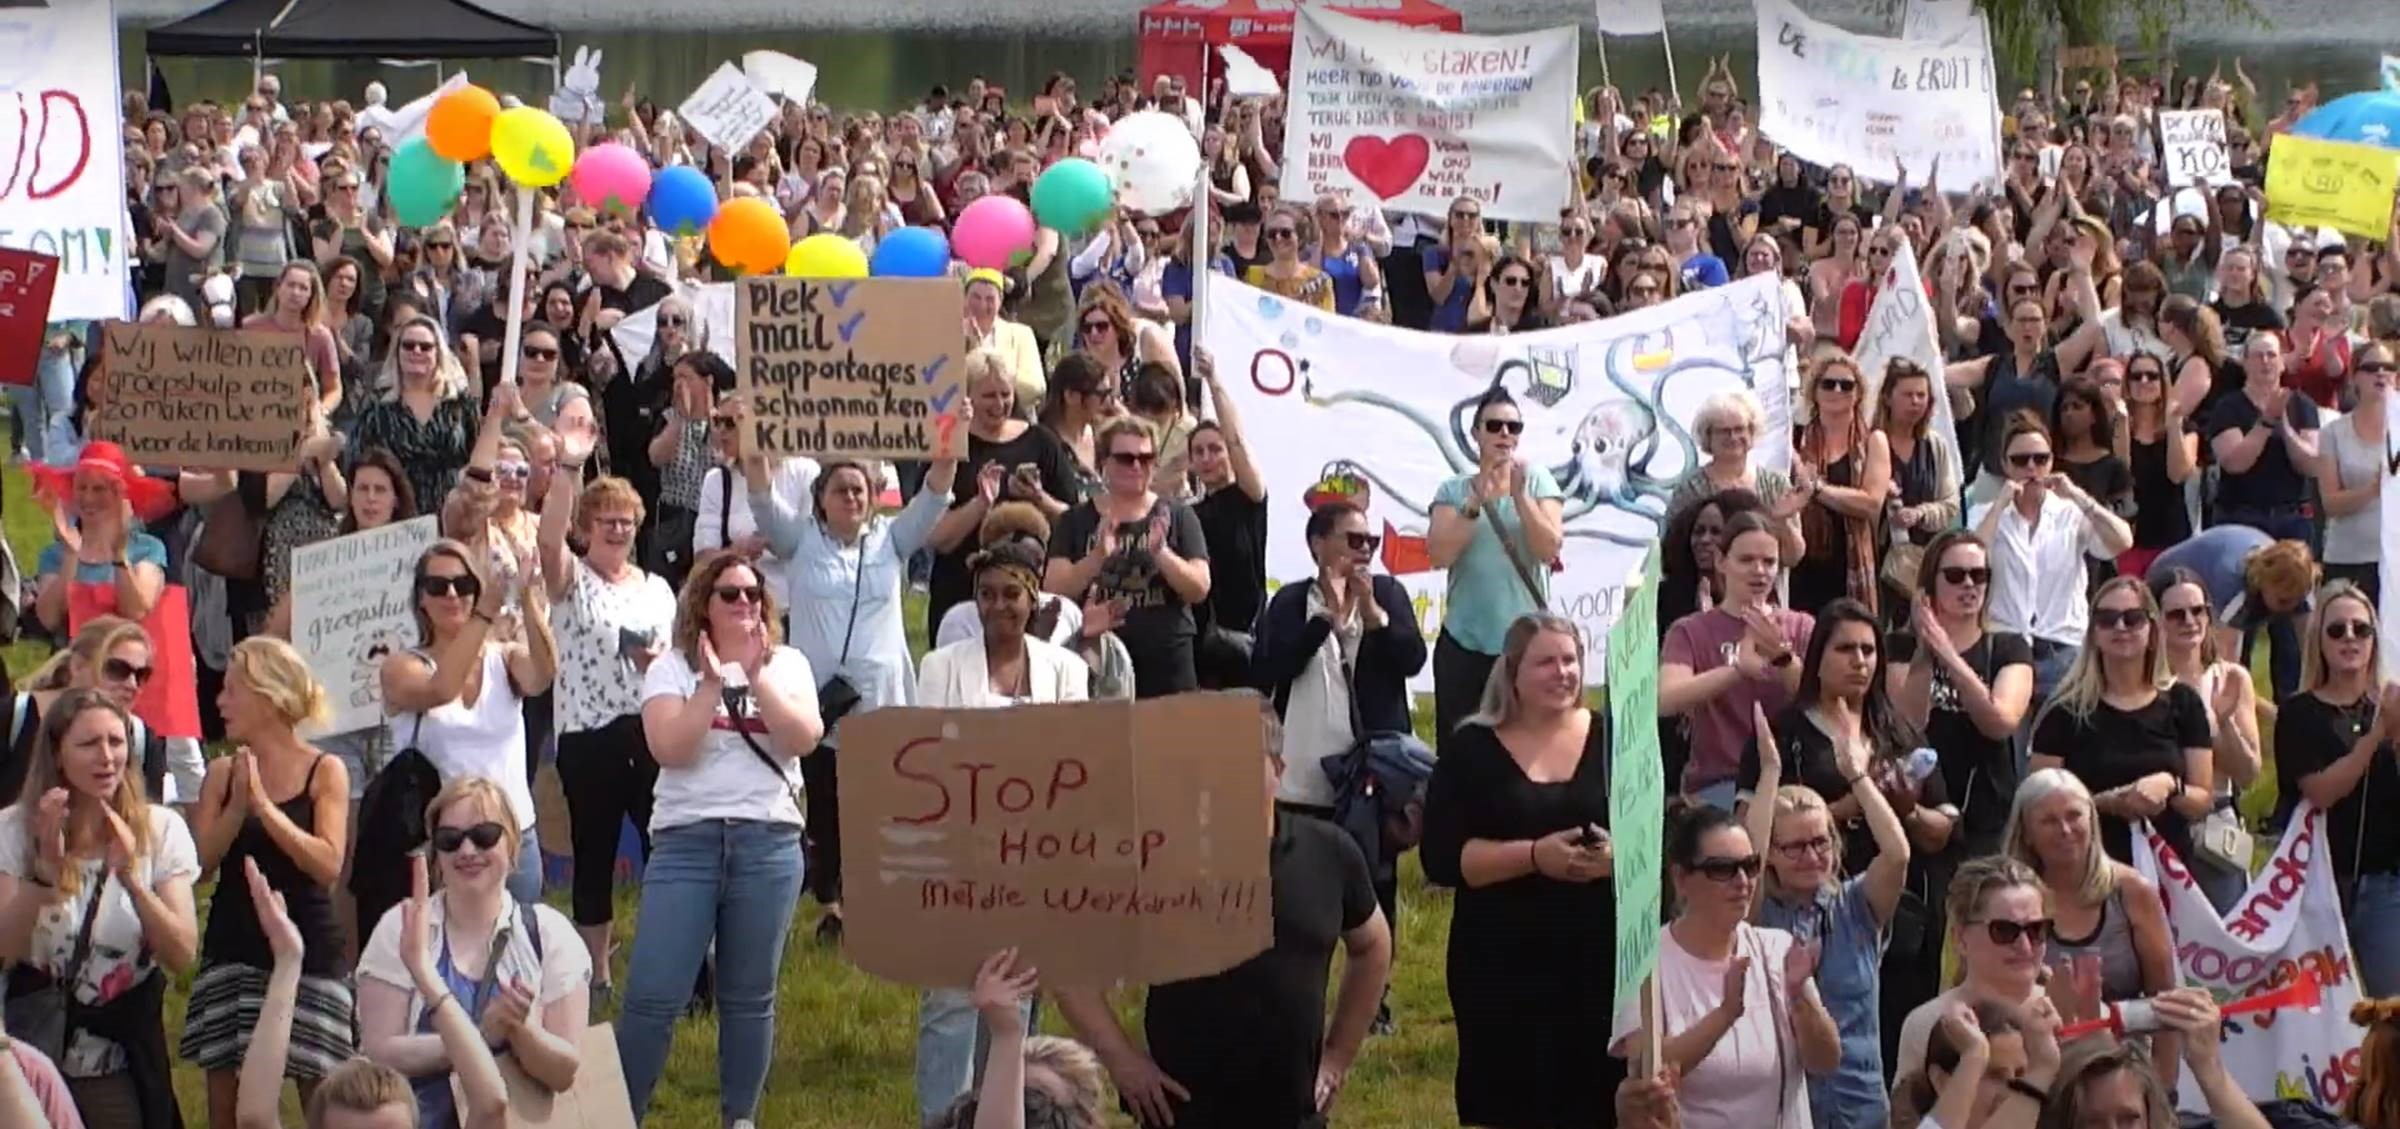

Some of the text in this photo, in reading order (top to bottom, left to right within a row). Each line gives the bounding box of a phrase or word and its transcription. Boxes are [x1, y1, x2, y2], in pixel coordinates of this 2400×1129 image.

[747, 280, 820, 318] Plek
[750, 347, 917, 398] Rapportages
[755, 418, 827, 452] Kind
